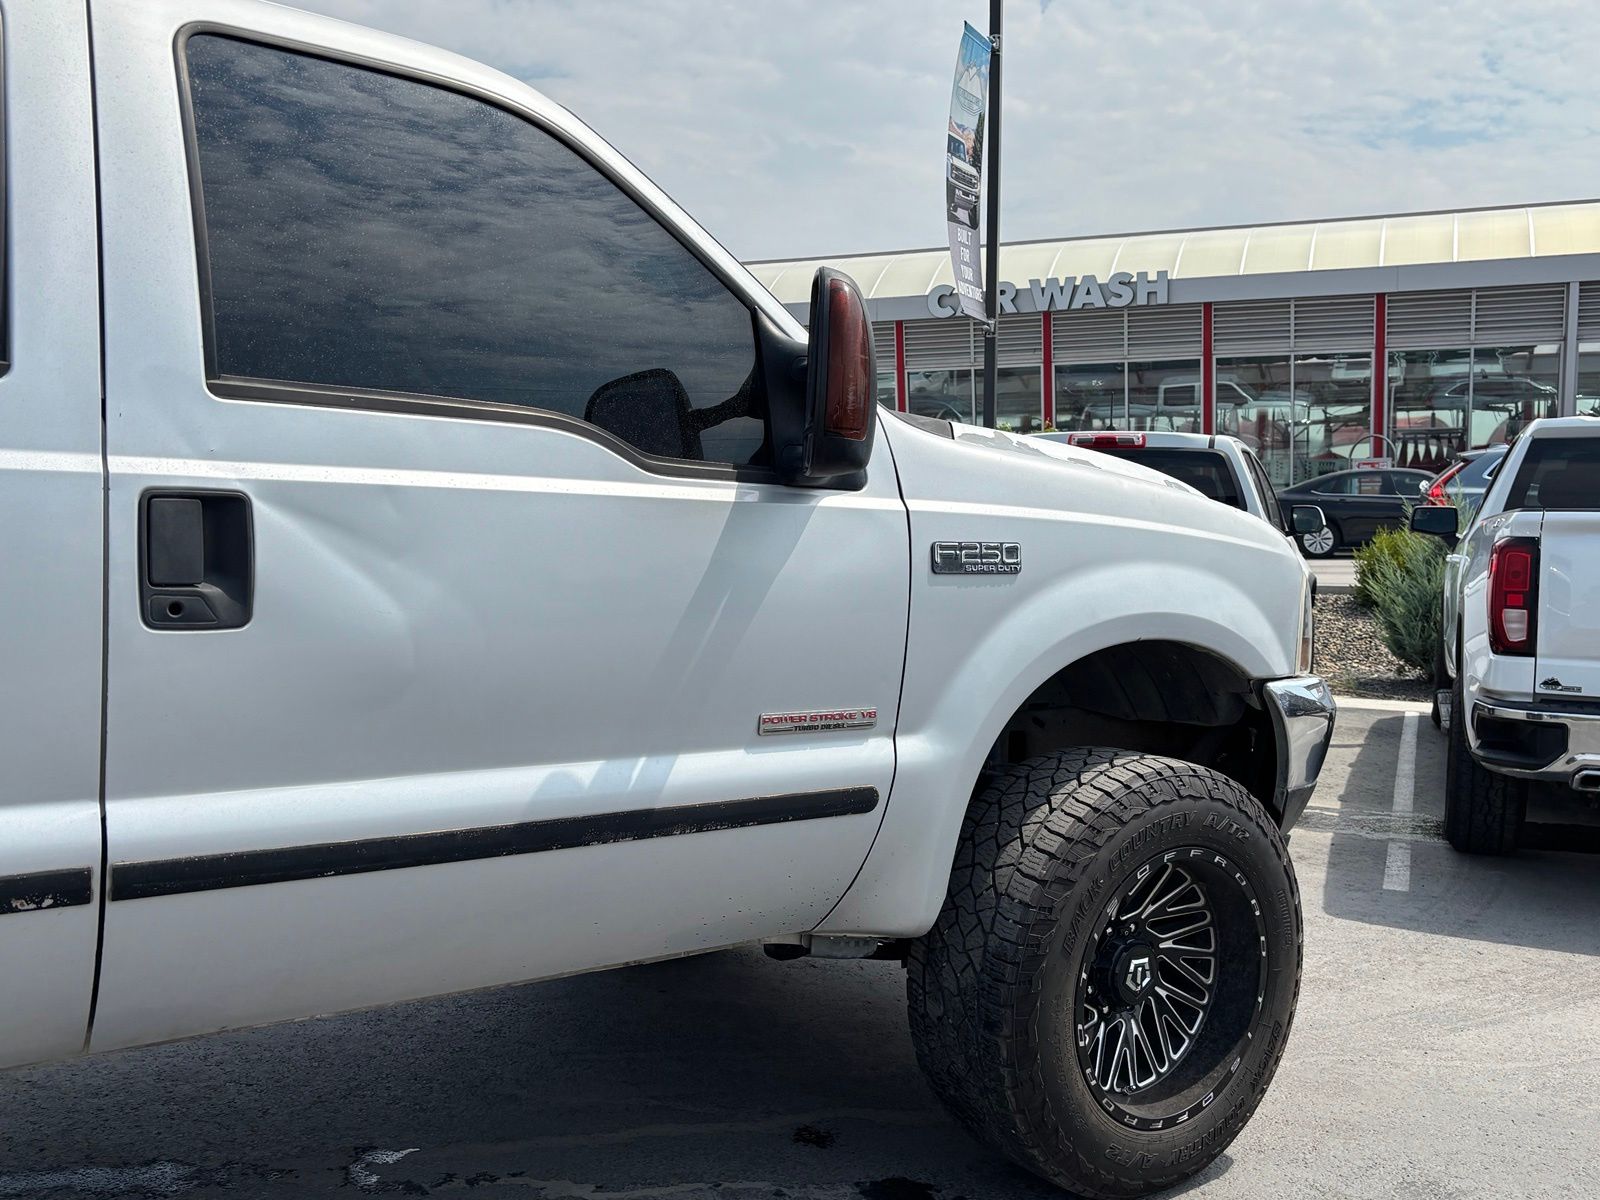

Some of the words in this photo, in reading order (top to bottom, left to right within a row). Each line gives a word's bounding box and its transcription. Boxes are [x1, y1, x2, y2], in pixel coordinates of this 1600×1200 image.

[957, 227, 972, 246] BUILT
[960, 246, 970, 265] FOR
[960, 264, 974, 282] YOUR
[927, 280, 1018, 319] CR
[1028, 270, 1169, 312] WASH
[957, 279, 984, 303] ADVENTURE
[965, 564, 997, 572] SUPER
[997, 564, 1022, 572] DUTY
[762, 714, 808, 725] POWER
[809, 711, 858, 723] STROKE
[860, 710, 877, 719] V8
[793, 722, 820, 732] TURBO
[820, 721, 847, 730] DIESEL
[1108, 810, 1199, 872] COUNTRY
[1203, 811, 1251, 845] A/T2
